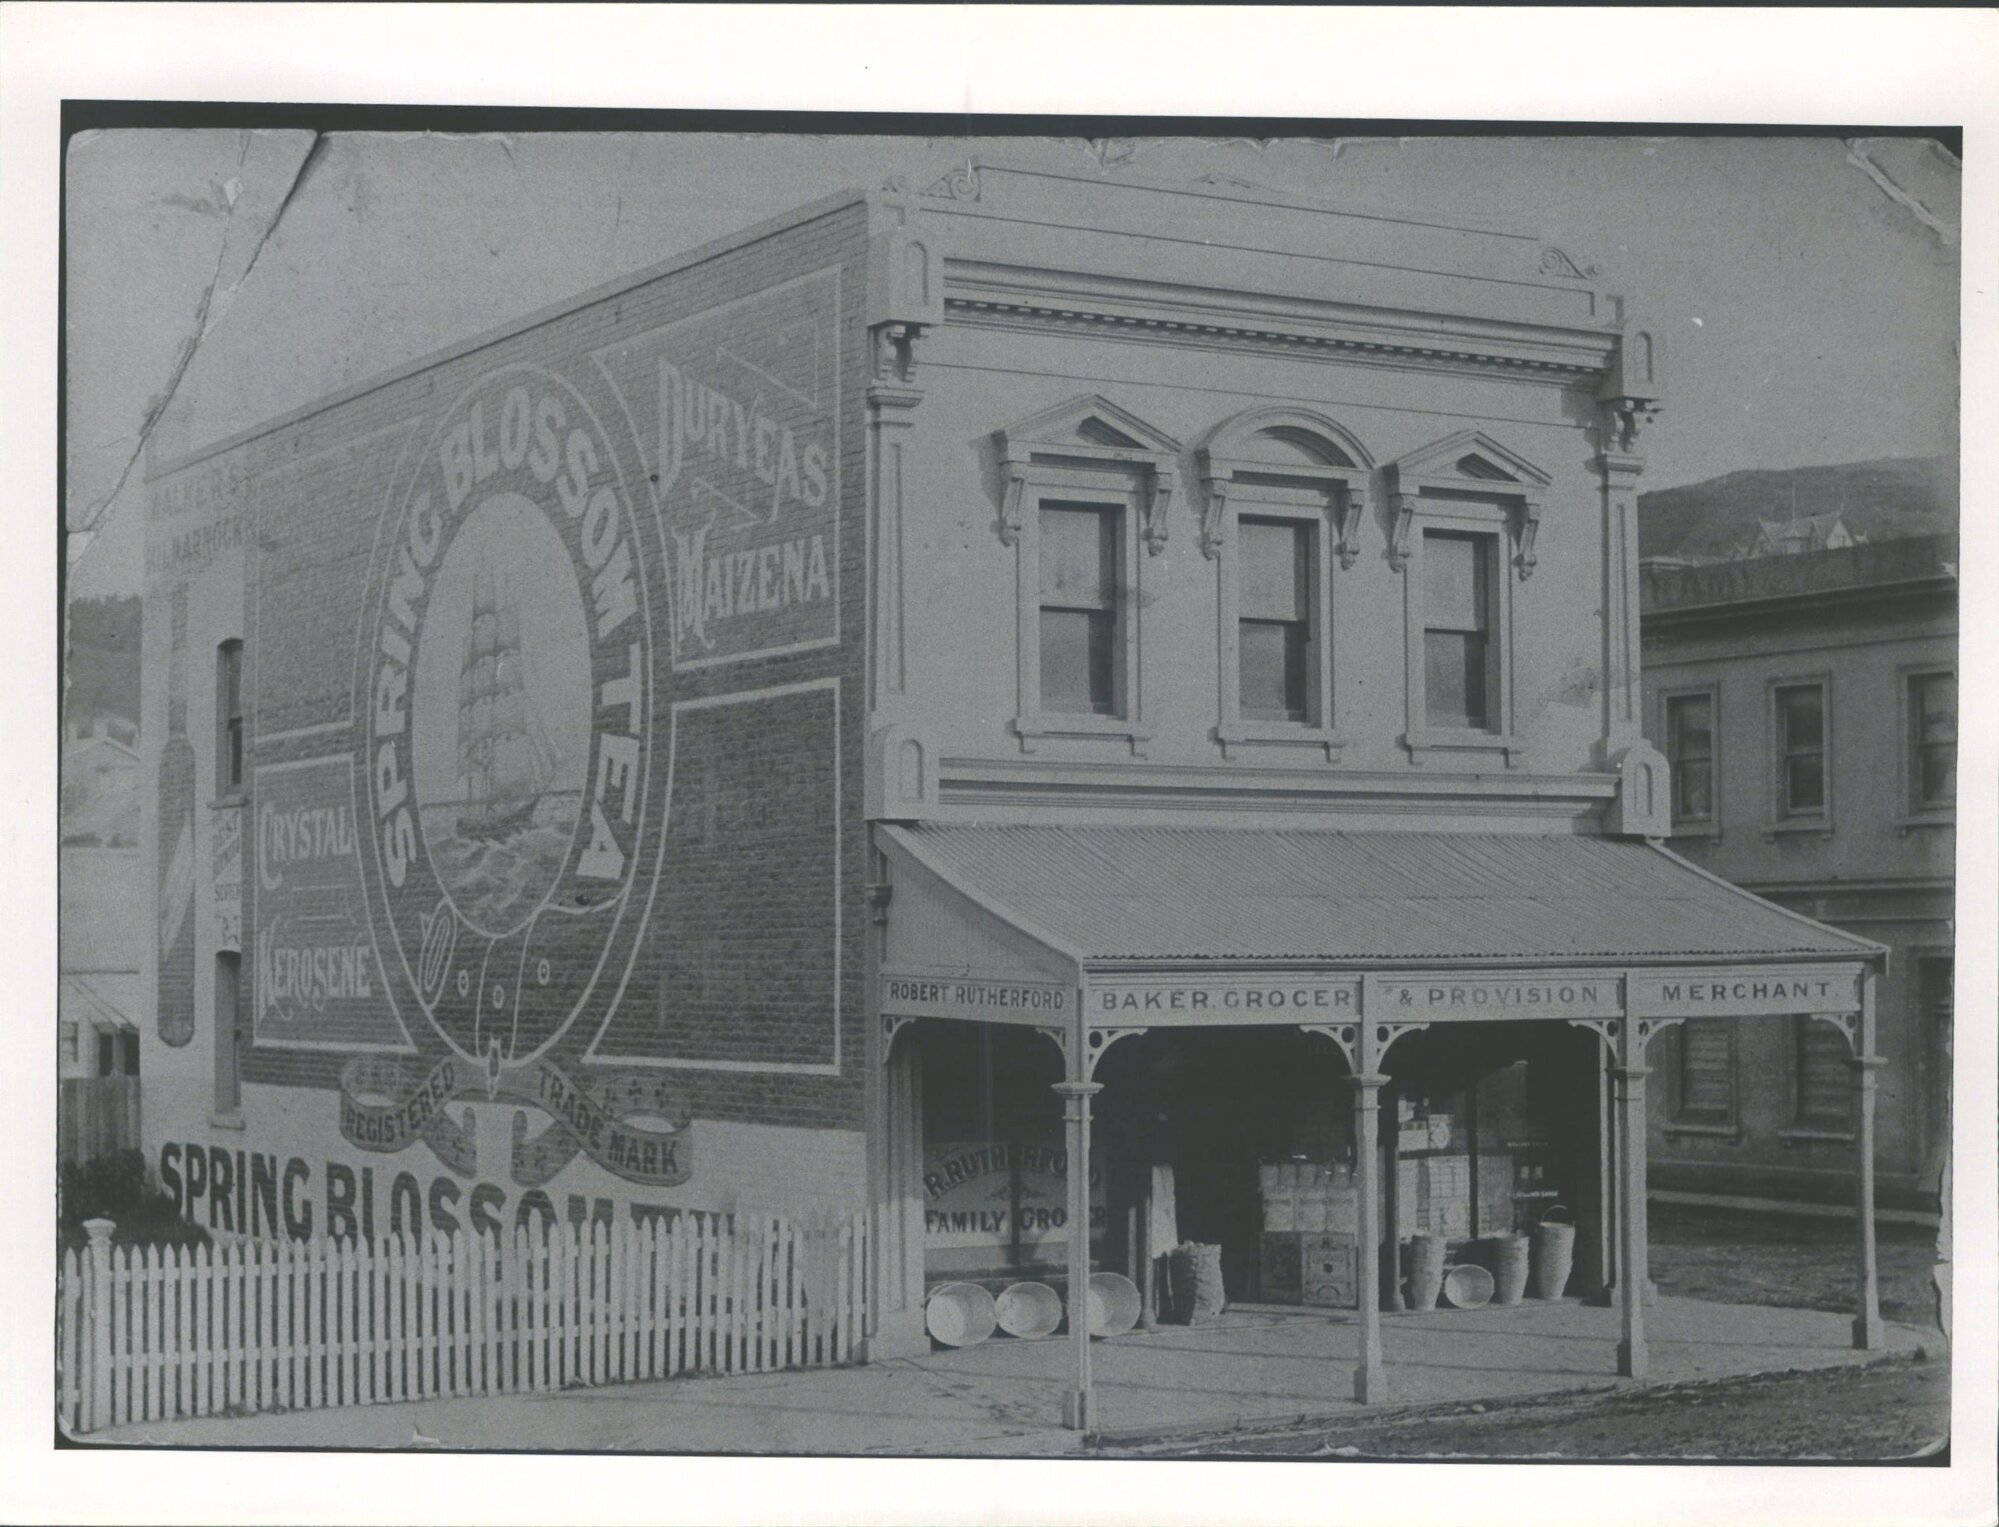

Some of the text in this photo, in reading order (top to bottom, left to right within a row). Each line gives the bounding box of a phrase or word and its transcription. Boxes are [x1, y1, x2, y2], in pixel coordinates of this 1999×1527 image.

[659, 357, 827, 526] DURYEAS
[671, 511, 830, 650] MAIZENA
[375, 386, 641, 888] SPRING BLOSSOM TEA
[260, 801, 353, 891] CRYSTAL
[259, 914, 371, 1023] KEROSENE
[891, 982, 1064, 1010] ROBERT RUTHERFORD
[1223, 989, 1352, 1008] GROCER
[1399, 986, 1598, 1006] & PROVISION
[346, 1064, 679, 1175] REGISTERED TRADE MARK
[161, 1142, 313, 1245] SPRING
[924, 1206, 1106, 1234] FAMILY GROER
